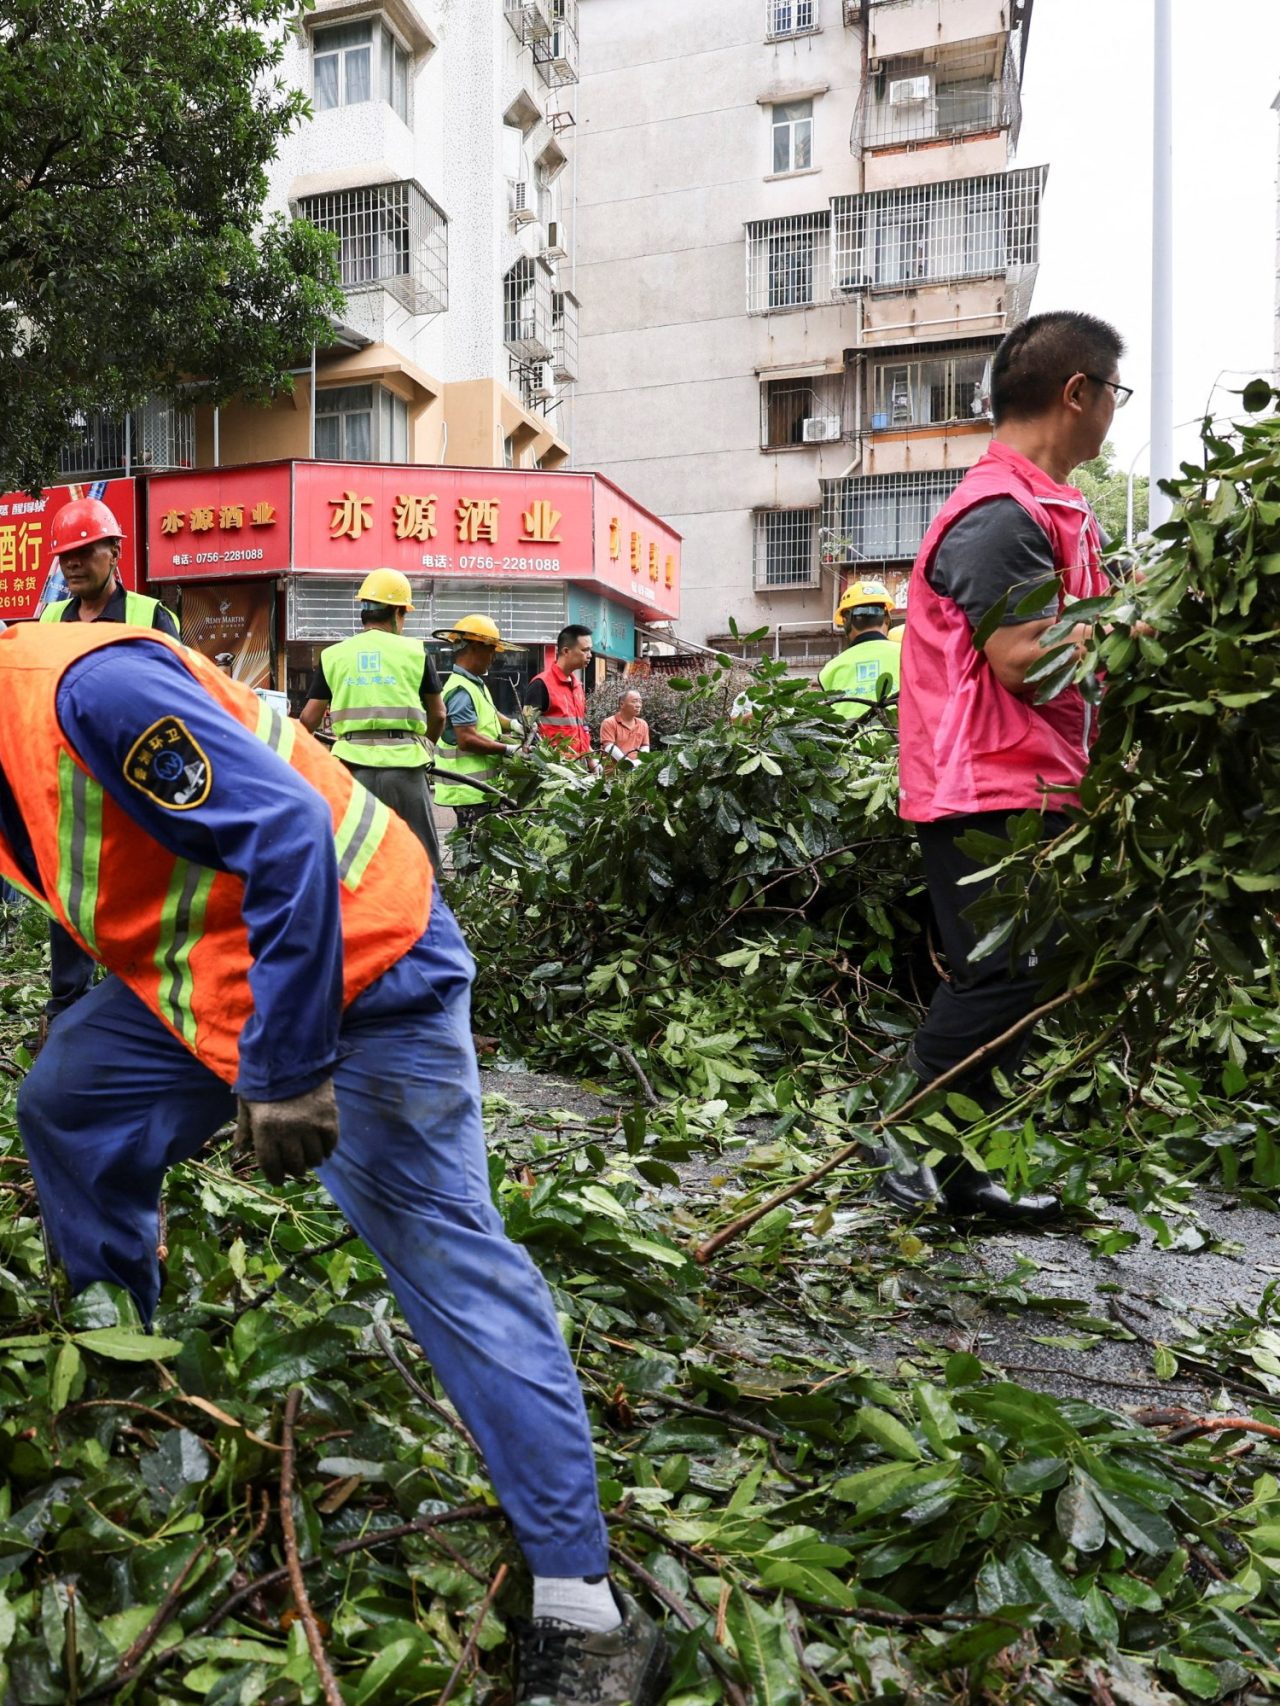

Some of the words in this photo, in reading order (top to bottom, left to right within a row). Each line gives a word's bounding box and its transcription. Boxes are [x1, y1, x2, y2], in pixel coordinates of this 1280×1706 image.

[161, 502, 277, 534] 亦源酒业
[328, 490, 563, 544] 亦源酒业
[13, 576, 37, 592] 杂货
